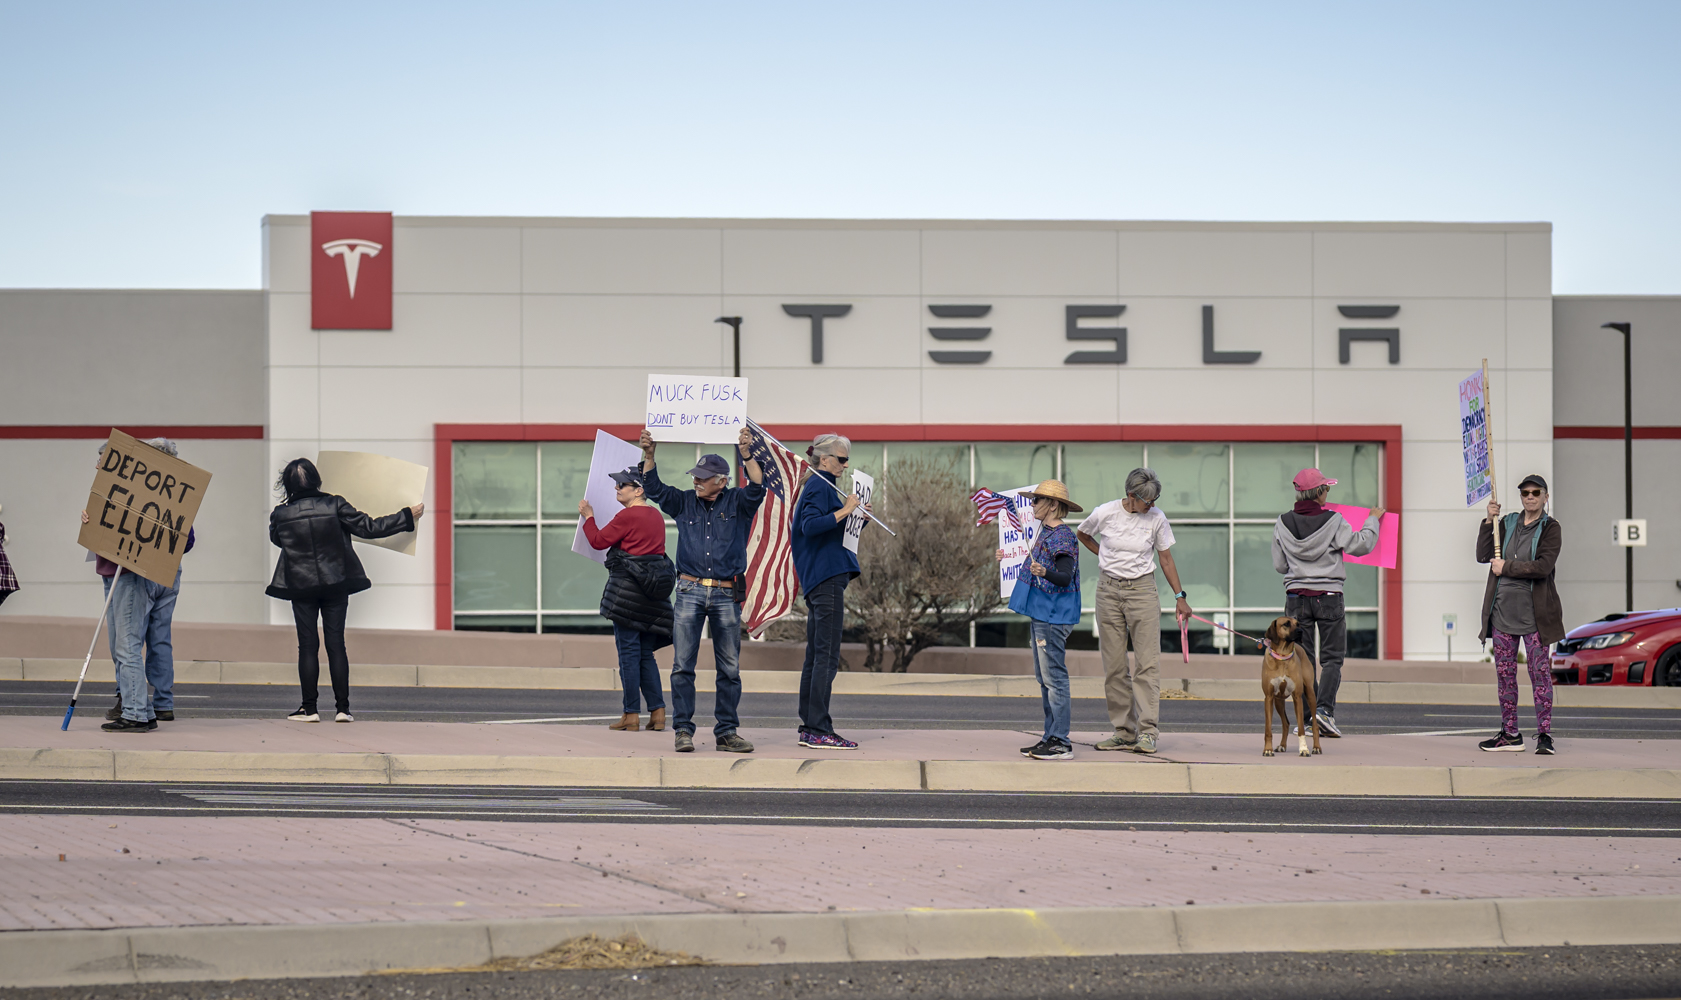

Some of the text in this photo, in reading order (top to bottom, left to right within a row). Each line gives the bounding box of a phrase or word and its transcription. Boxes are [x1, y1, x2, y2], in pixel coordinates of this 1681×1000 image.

[781, 304, 1401, 364] TESLA
[649, 383, 743, 402] MUCK FUSK
[647, 412, 741, 426] DONT BUY TESLA
[101, 447, 195, 503] DEPORT
[855, 480, 871, 506] BAD
[100, 483, 186, 555] ELON
[1004, 529, 1019, 544] HAS
[1628, 525, 1640, 540] B
[116, 537, 143, 563] !!!
